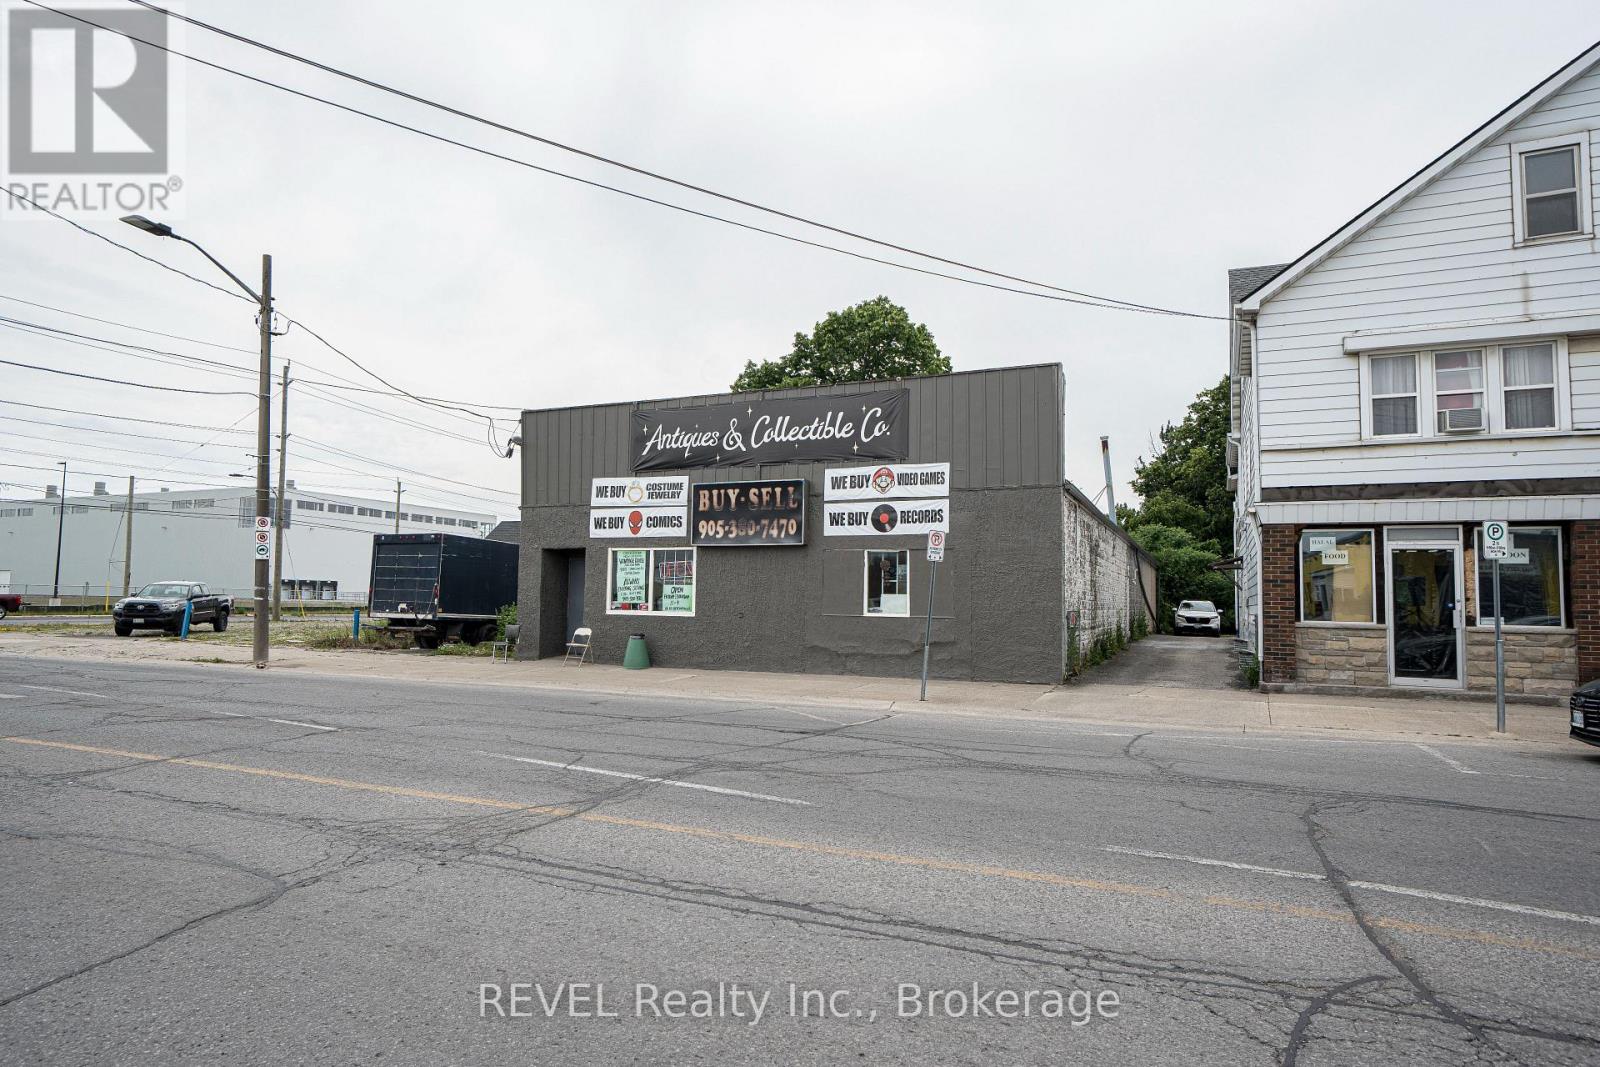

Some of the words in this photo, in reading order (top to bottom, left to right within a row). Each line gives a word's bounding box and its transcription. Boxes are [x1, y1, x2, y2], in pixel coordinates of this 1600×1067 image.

[641, 423, 720, 459] Antiques
[722, 418, 747, 452] &
[750, 411, 855, 449] Collectible
[860, 407, 891, 443] Co.
[830, 475, 848, 490] WE
[849, 474, 872, 489] BUY
[896, 472, 919, 486] VIDEO
[919, 471, 946, 485] GAMES
[595, 485, 609, 499] WE
[609, 485, 627, 498] BUY
[646, 482, 684, 491] COSTUME
[647, 490, 682, 500] JEWELRY
[593, 516, 607, 530] WE
[608, 516, 625, 530] BUY
[646, 515, 683, 528] COMICS
[828, 511, 846, 526] WE
[847, 511, 869, 526] BUY
[899, 508, 944, 525] RECORDS
